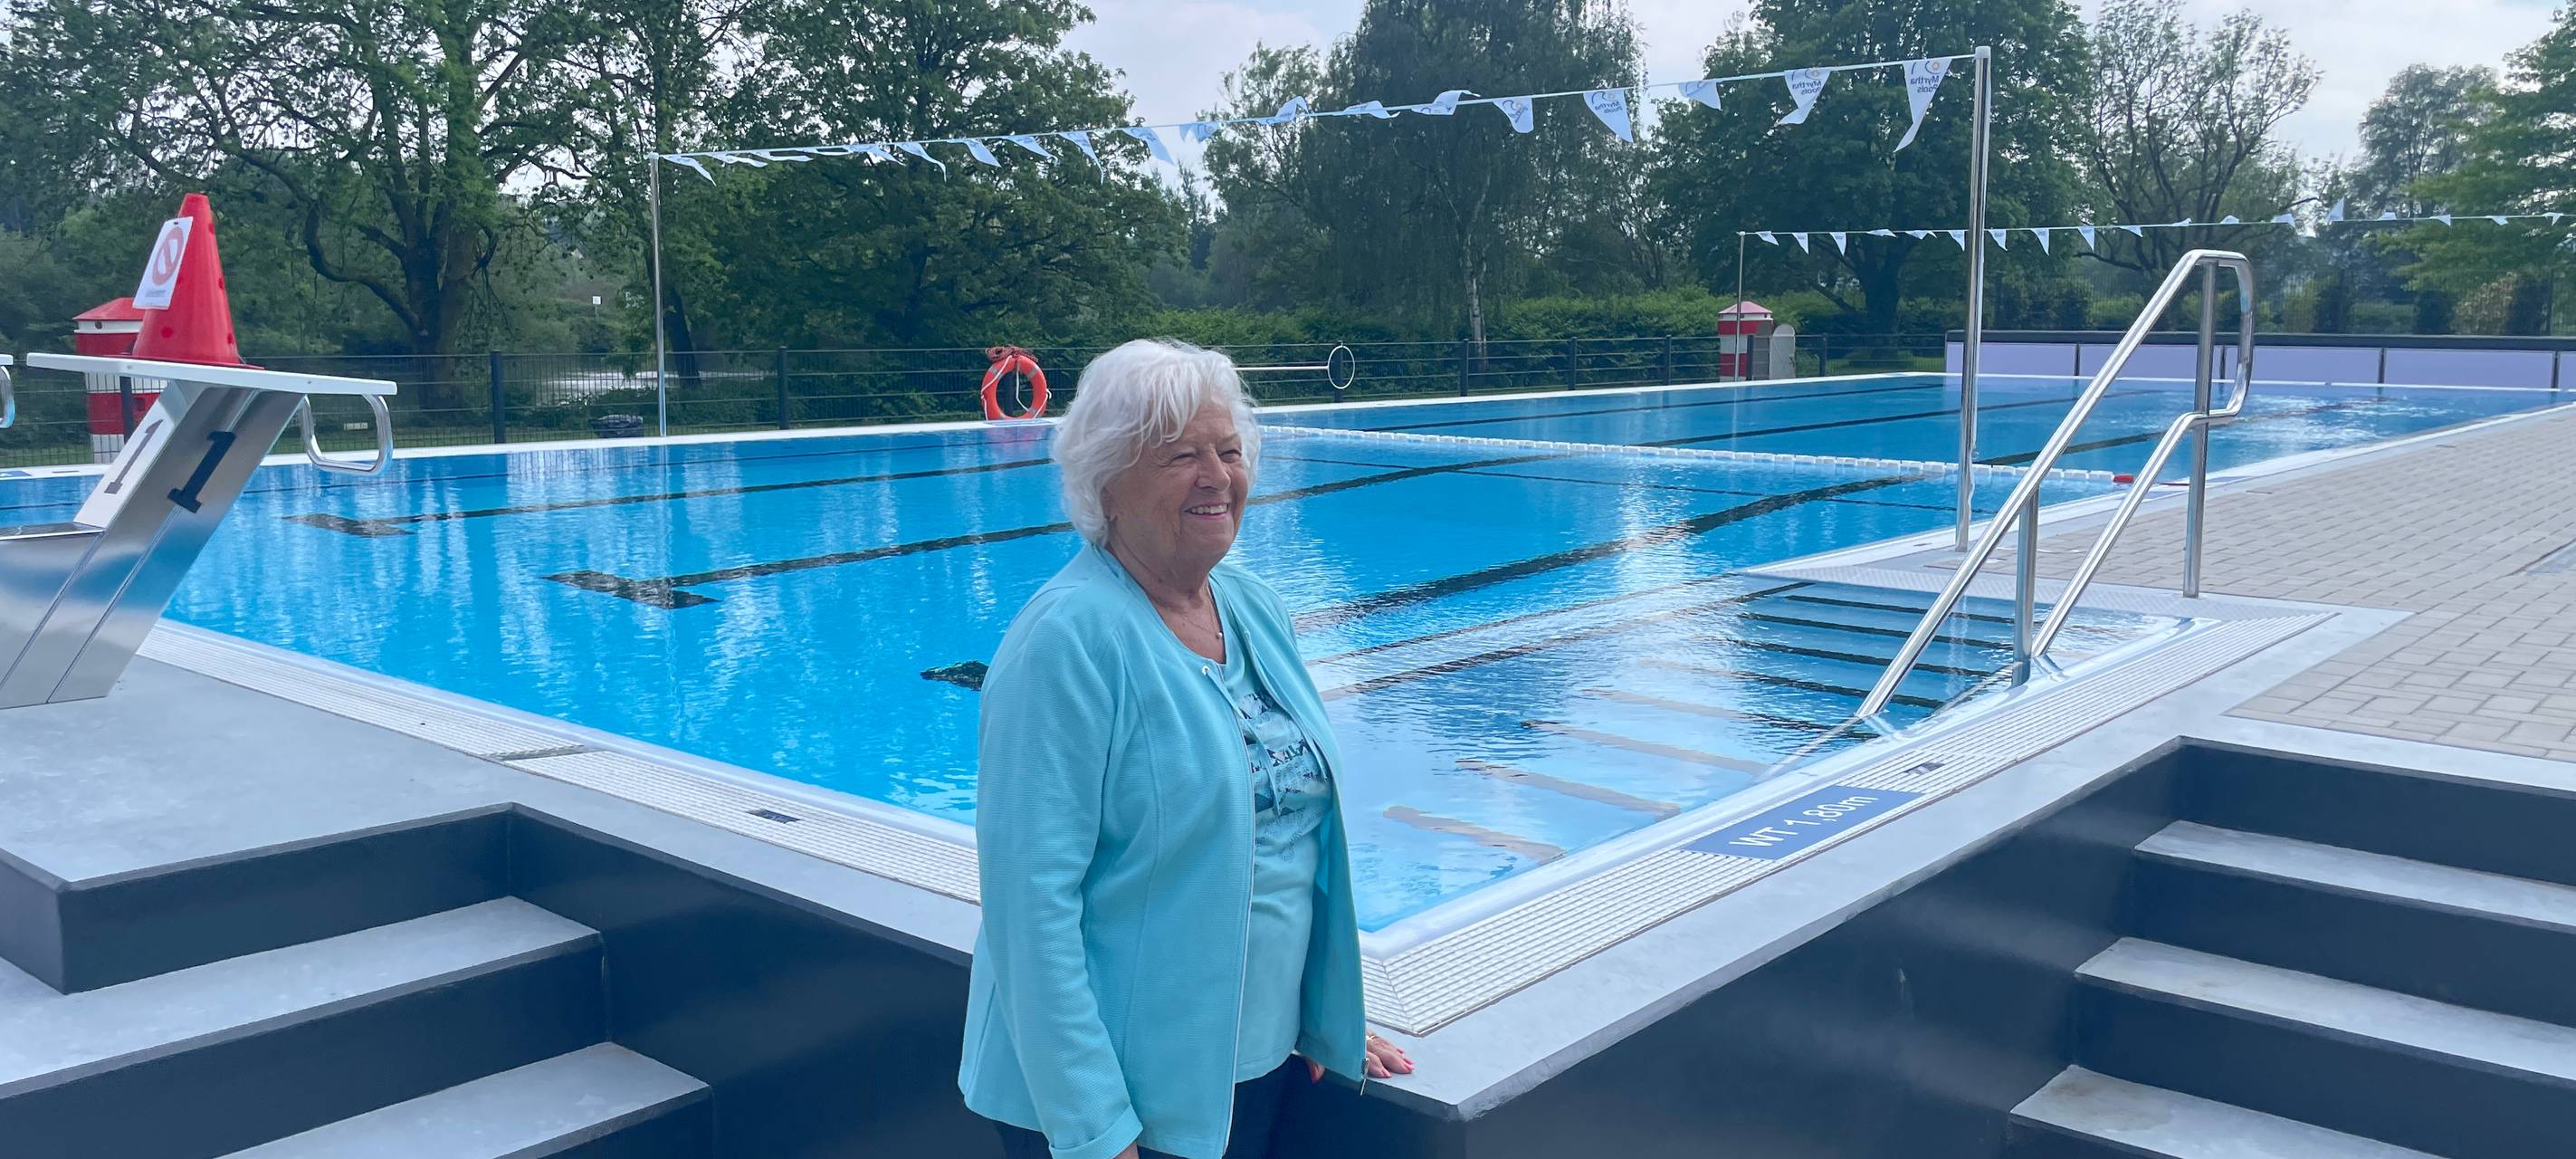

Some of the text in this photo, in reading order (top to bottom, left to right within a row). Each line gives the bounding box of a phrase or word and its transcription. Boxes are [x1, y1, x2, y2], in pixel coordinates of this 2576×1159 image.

[104, 419, 164, 494] 1
[167, 431, 237, 513] 1
[1729, 796, 1879, 847] WT 1,80m
